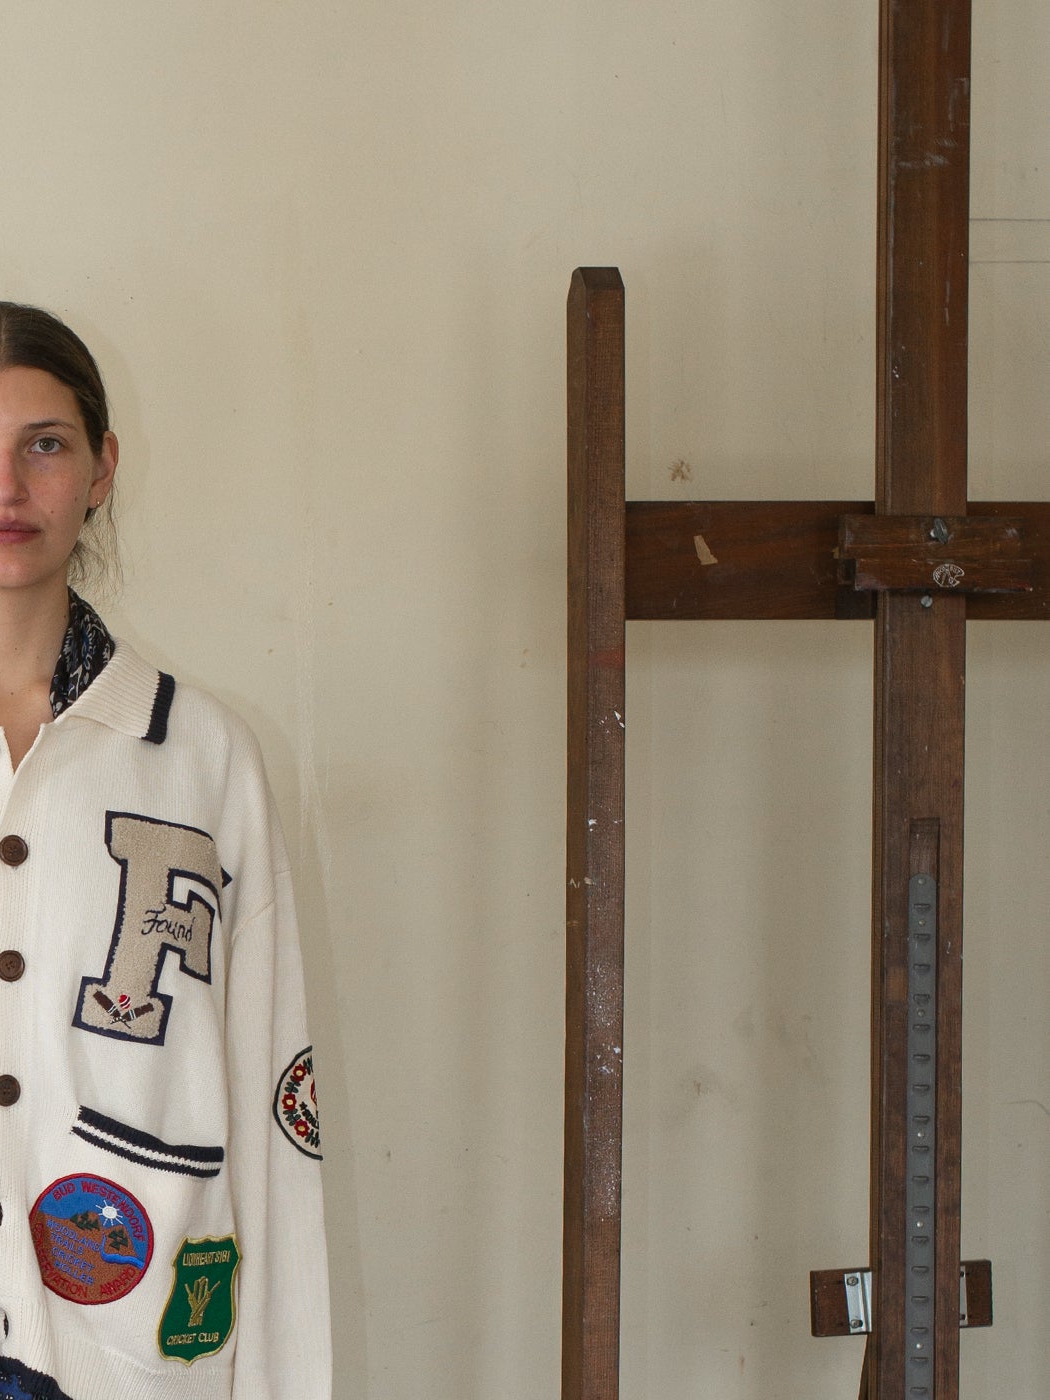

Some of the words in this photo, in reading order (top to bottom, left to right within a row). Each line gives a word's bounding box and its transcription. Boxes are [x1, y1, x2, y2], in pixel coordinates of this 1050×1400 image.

[141, 903, 196, 942] Found
[53, 1182, 76, 1201] BUD
[46, 1219, 101, 1253] WOODLAND
[51, 1231, 83, 1255] TRAILS
[52, 1246, 94, 1272] CRICKET
[100, 1267, 136, 1296] AWARD
[166, 1333, 196, 1346] CRICKET
[198, 1332, 220, 1343] CLUB
